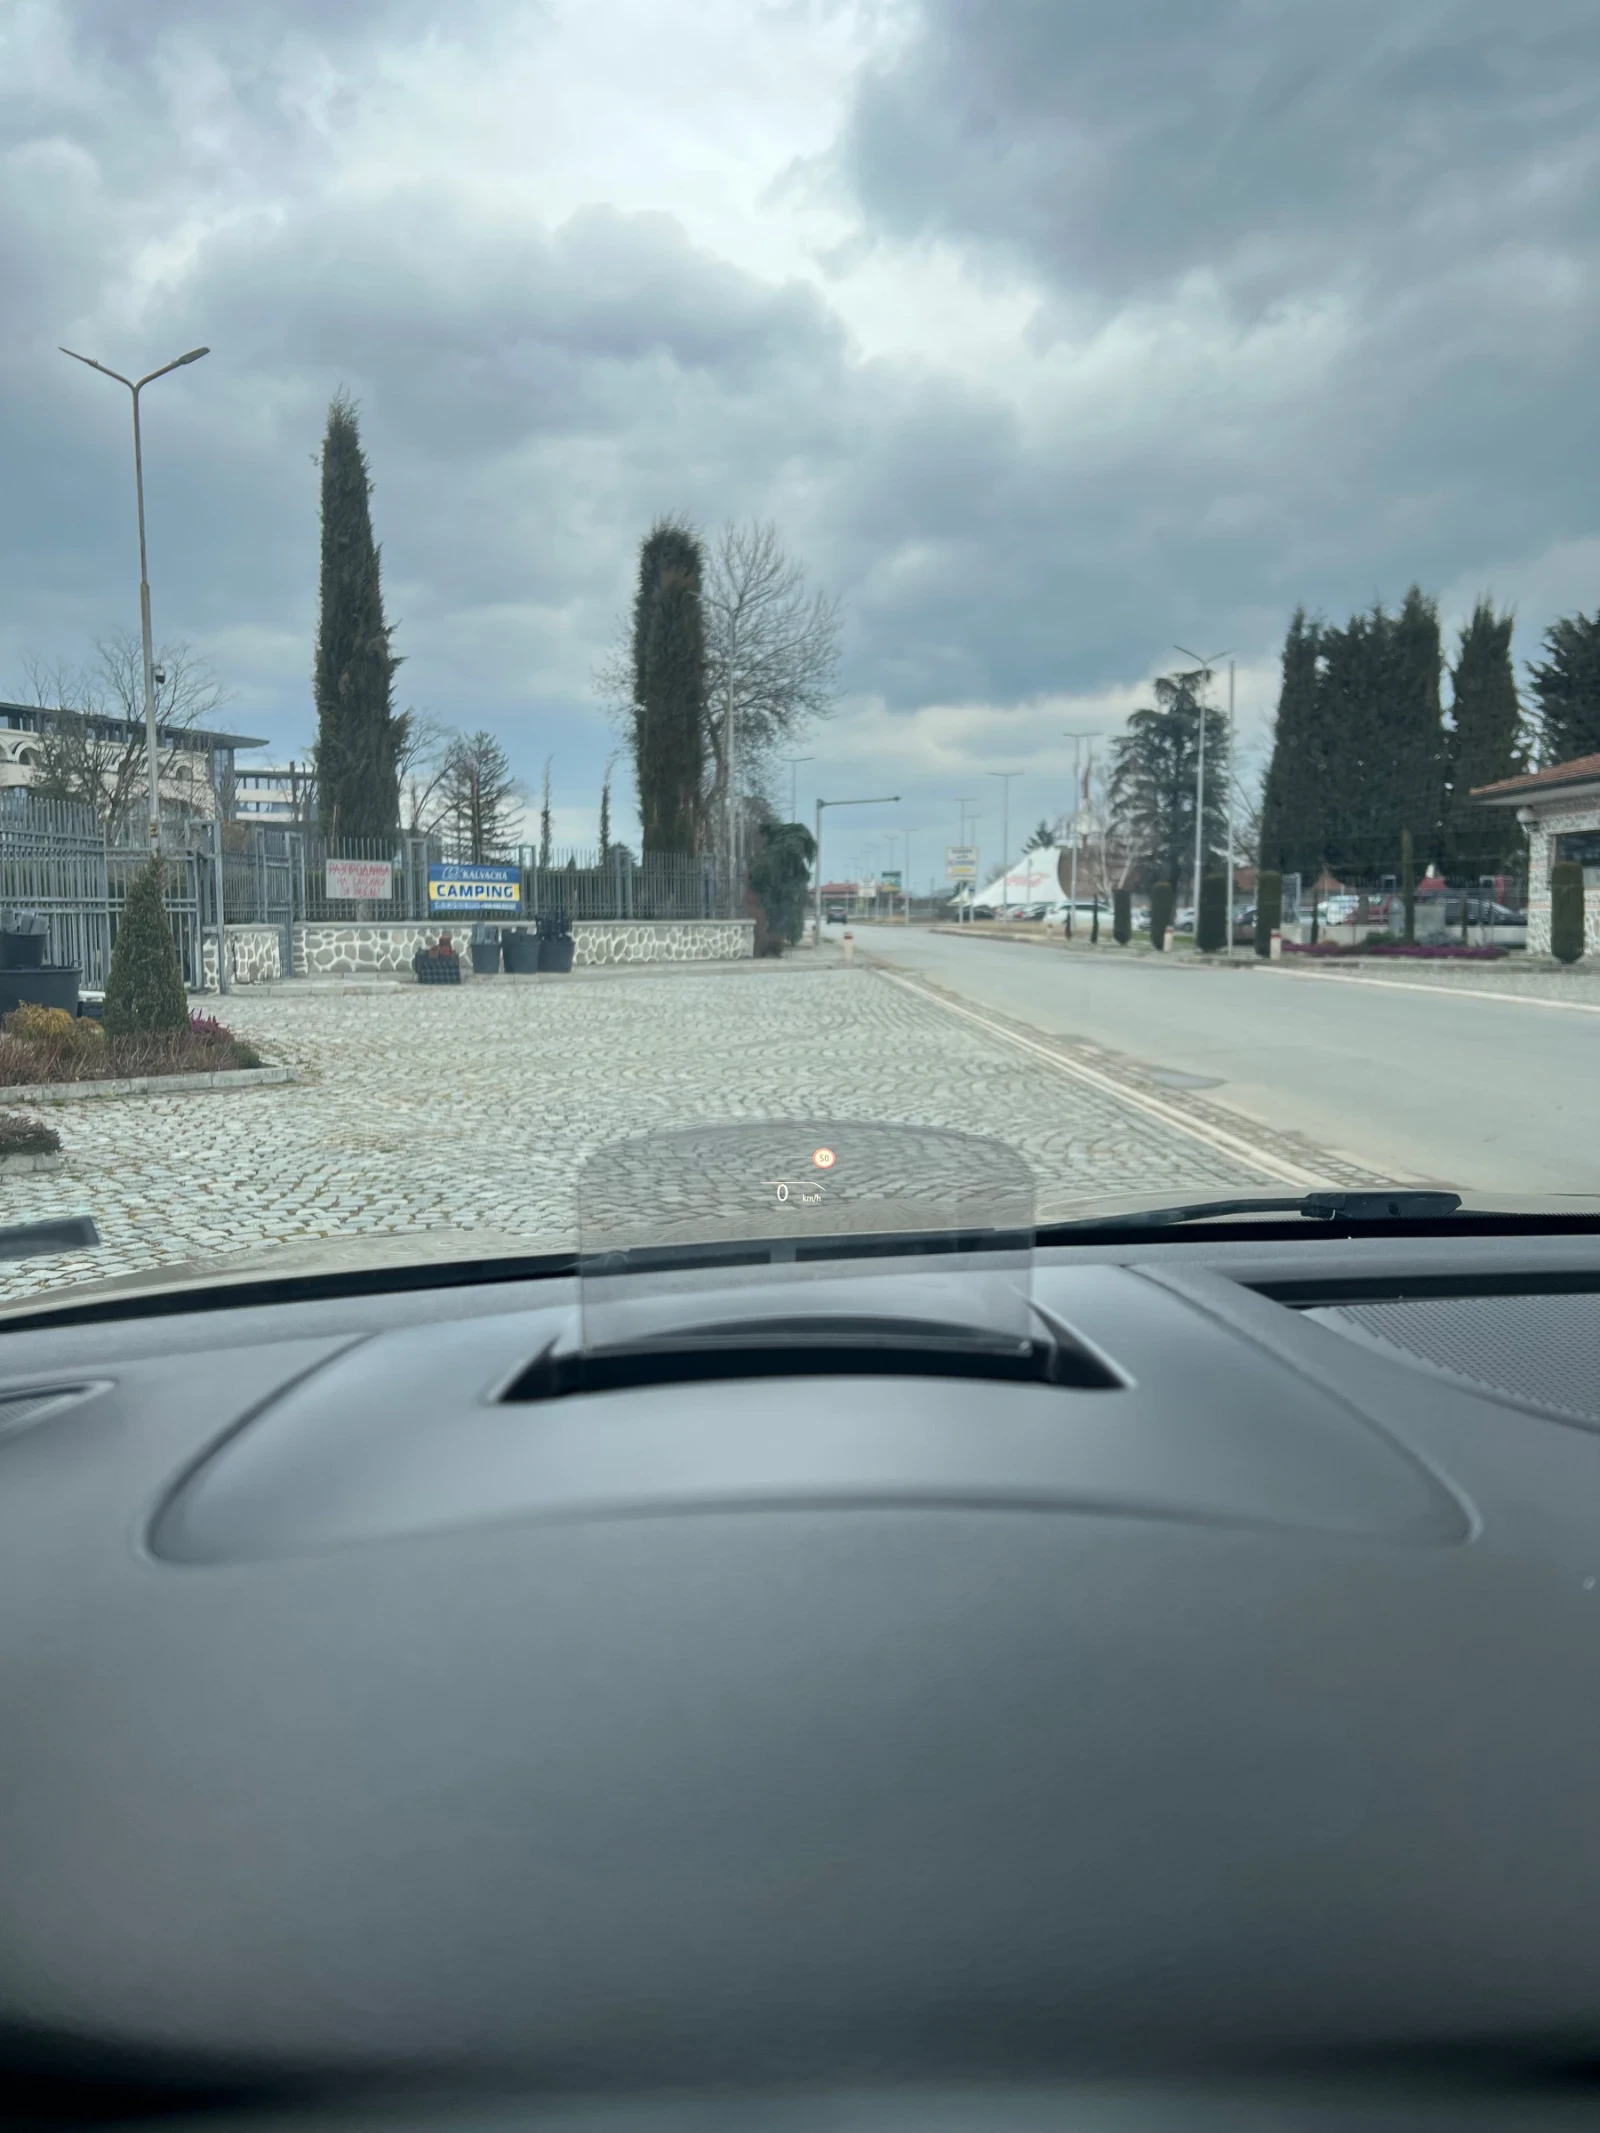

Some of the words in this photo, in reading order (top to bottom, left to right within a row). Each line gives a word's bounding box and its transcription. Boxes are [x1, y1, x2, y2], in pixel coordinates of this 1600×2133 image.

[436, 883, 513, 898] CAMPING
[777, 1184, 788, 1202] 0
[802, 1194, 821, 1203] km/h
